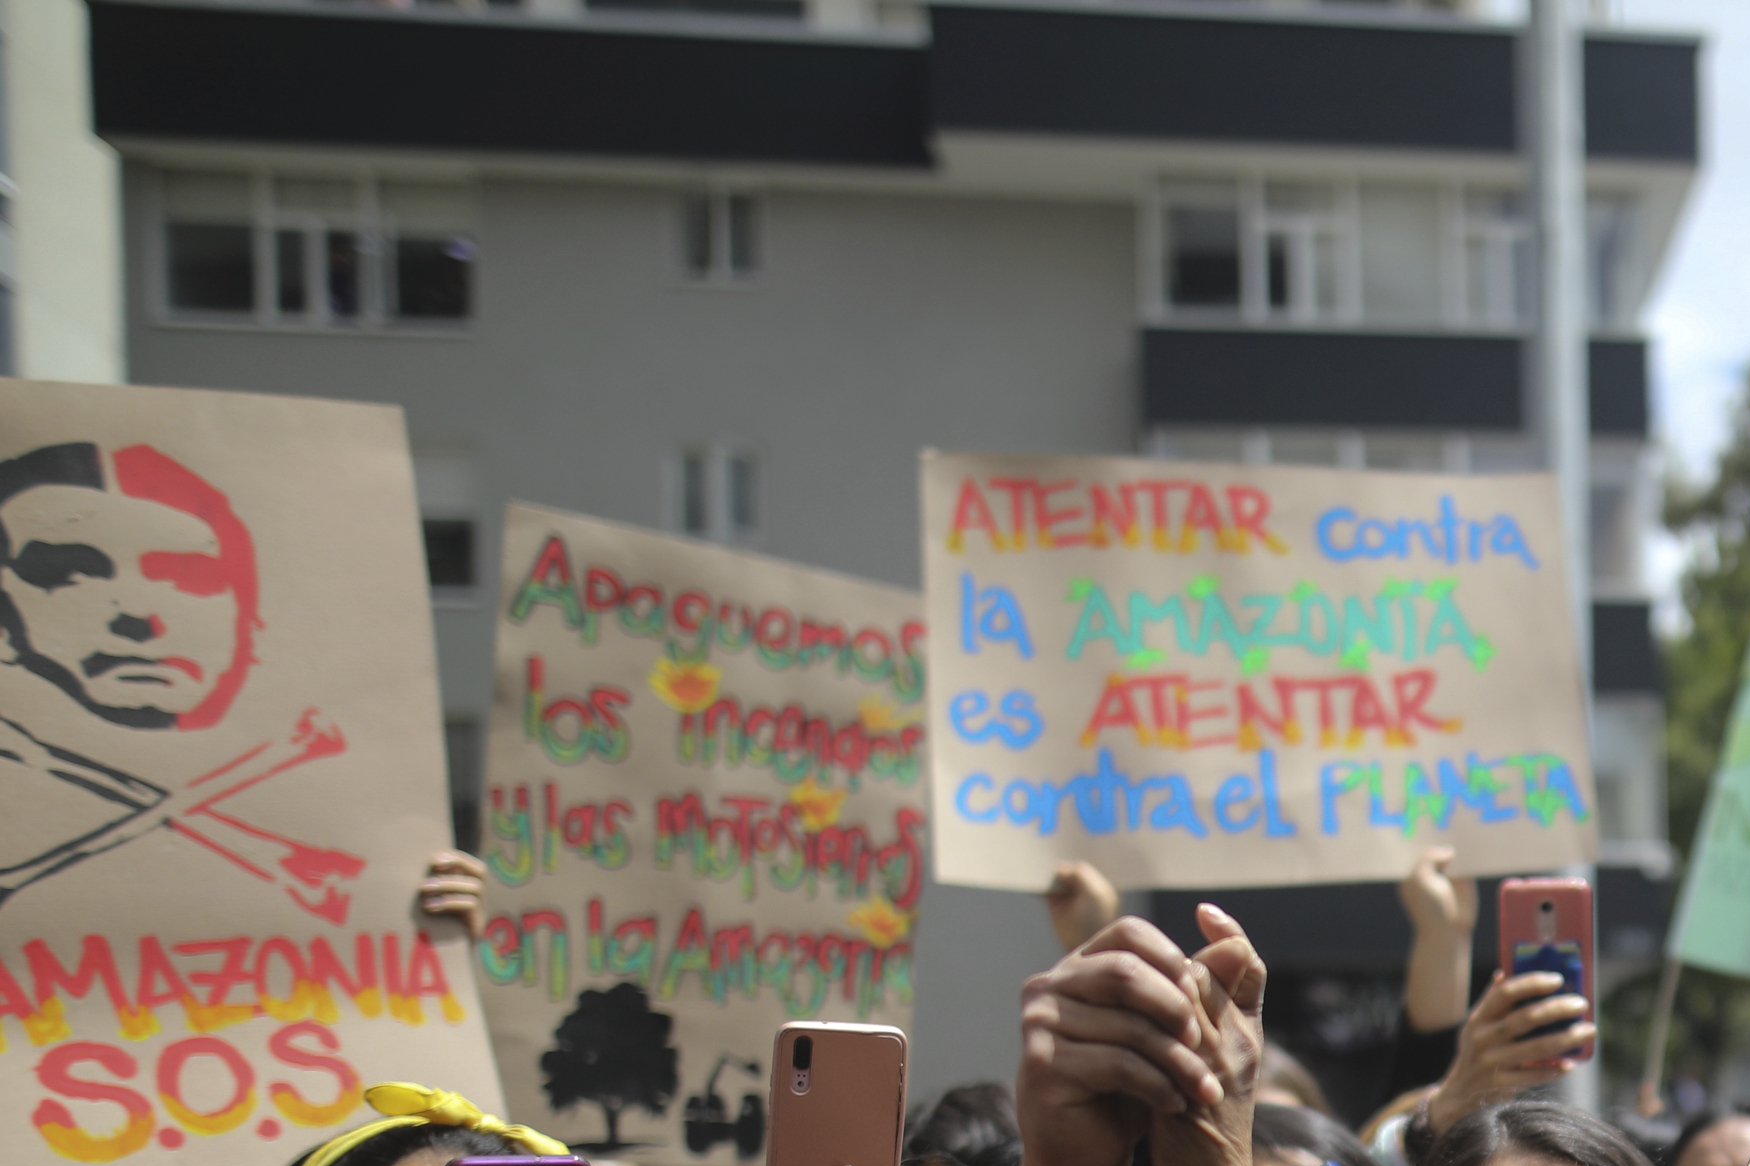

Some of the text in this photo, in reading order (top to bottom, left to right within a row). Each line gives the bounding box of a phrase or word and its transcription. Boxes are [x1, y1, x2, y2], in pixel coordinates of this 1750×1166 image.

[947, 477, 1289, 554] ATENTAR
[510, 534, 928, 704] Apaguemos
[960, 571, 1035, 660] la
[523, 652, 632, 766] los
[947, 669, 1463, 750] es ATENTAR
[1318, 752, 1590, 838] PLANETA
[0, 933, 465, 1053] AMAZONIA
[480, 908, 568, 1002] en
[586, 898, 656, 986] la
